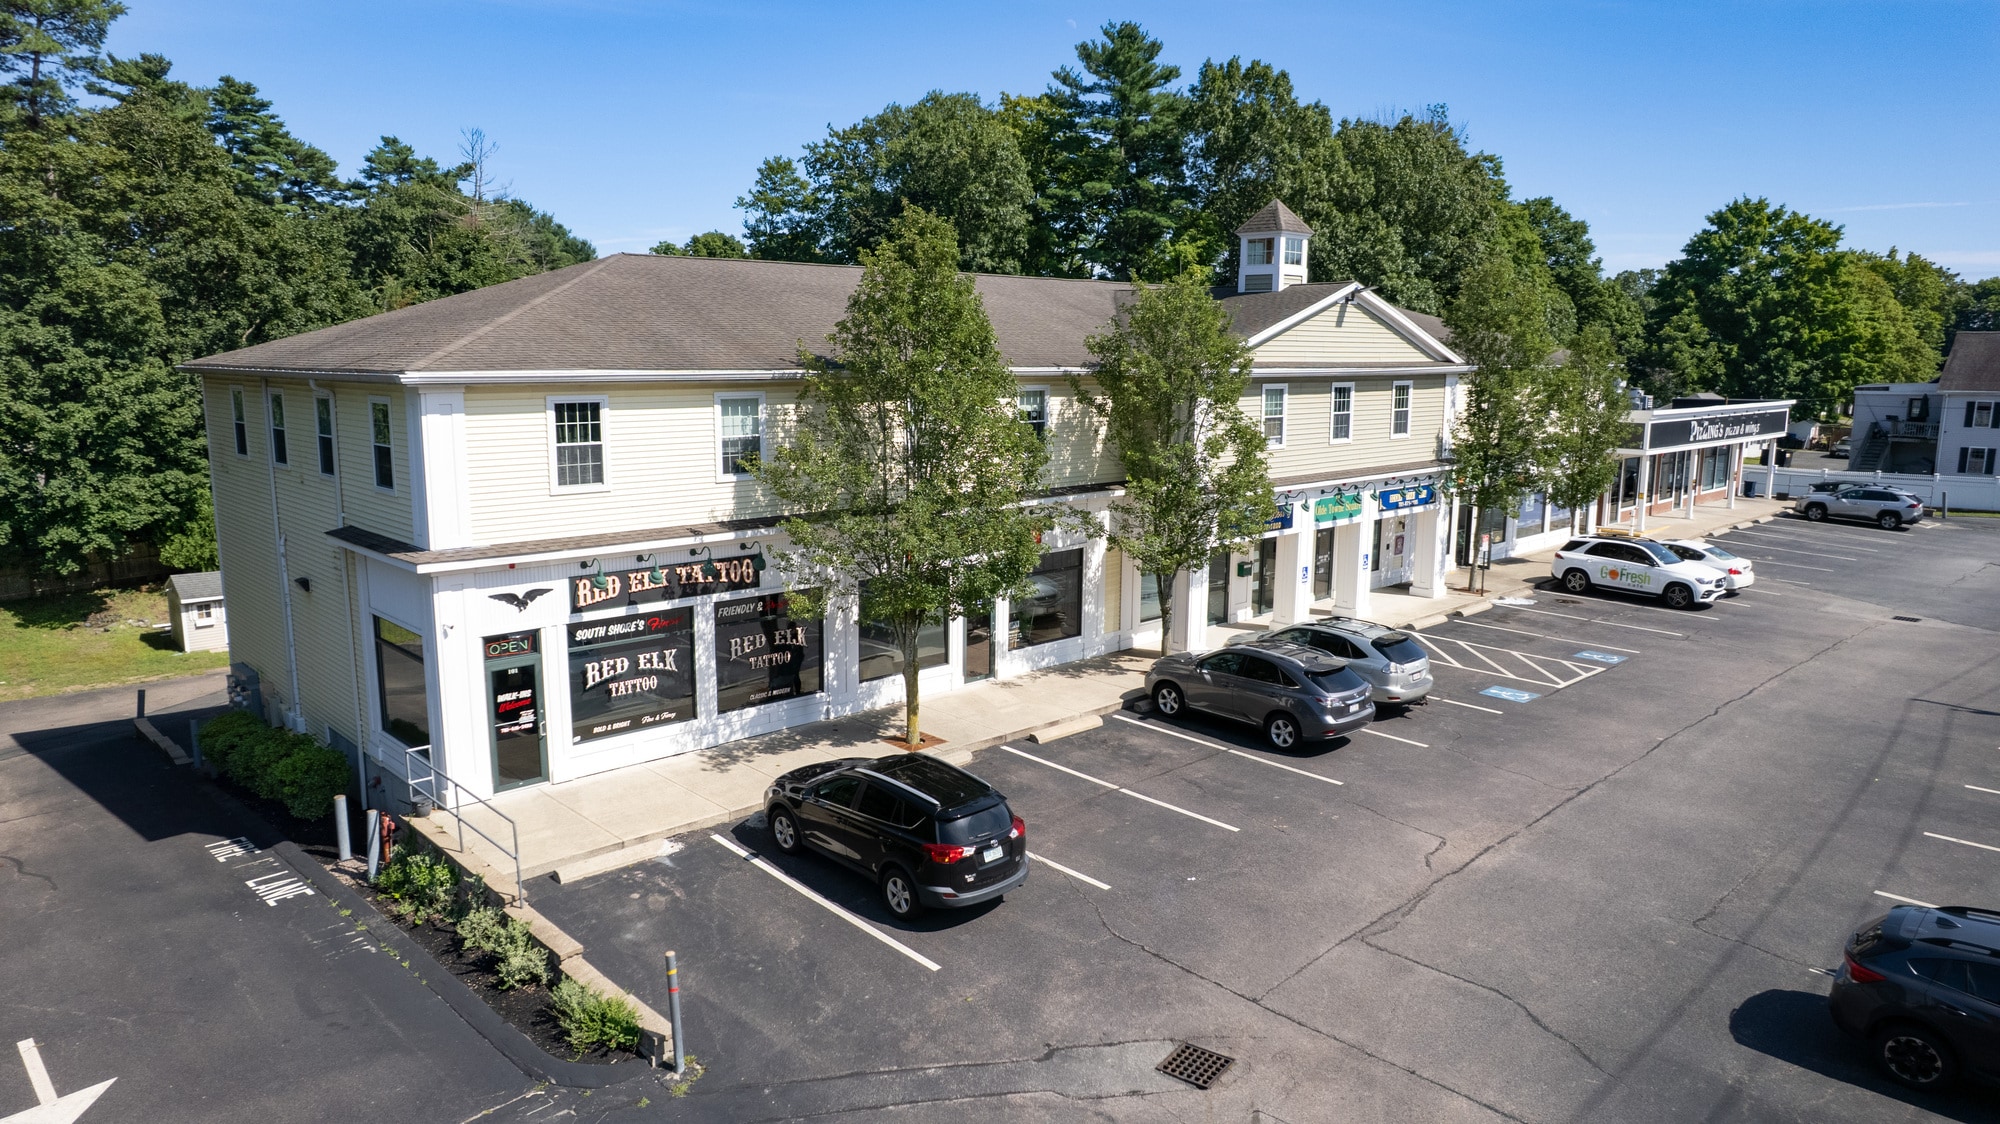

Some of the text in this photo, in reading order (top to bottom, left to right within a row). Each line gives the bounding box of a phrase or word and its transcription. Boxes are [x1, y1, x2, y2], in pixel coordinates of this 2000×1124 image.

[1724, 424, 1740, 438] pizza
[1745, 421, 1760, 435] wings
[718, 603, 755, 618] FRIENDLY
[757, 601, 763, 612] &
[575, 626, 606, 641] SOUTH
[607, 619, 645, 636] SHORE'S
[489, 640, 528, 655] OPEN
[729, 626, 808, 662] RED ELK
[584, 648, 678, 690] RED ELK
[749, 650, 791, 670] TATTOO
[609, 675, 658, 697] TATTOO
[245, 870, 315, 907] LANE
